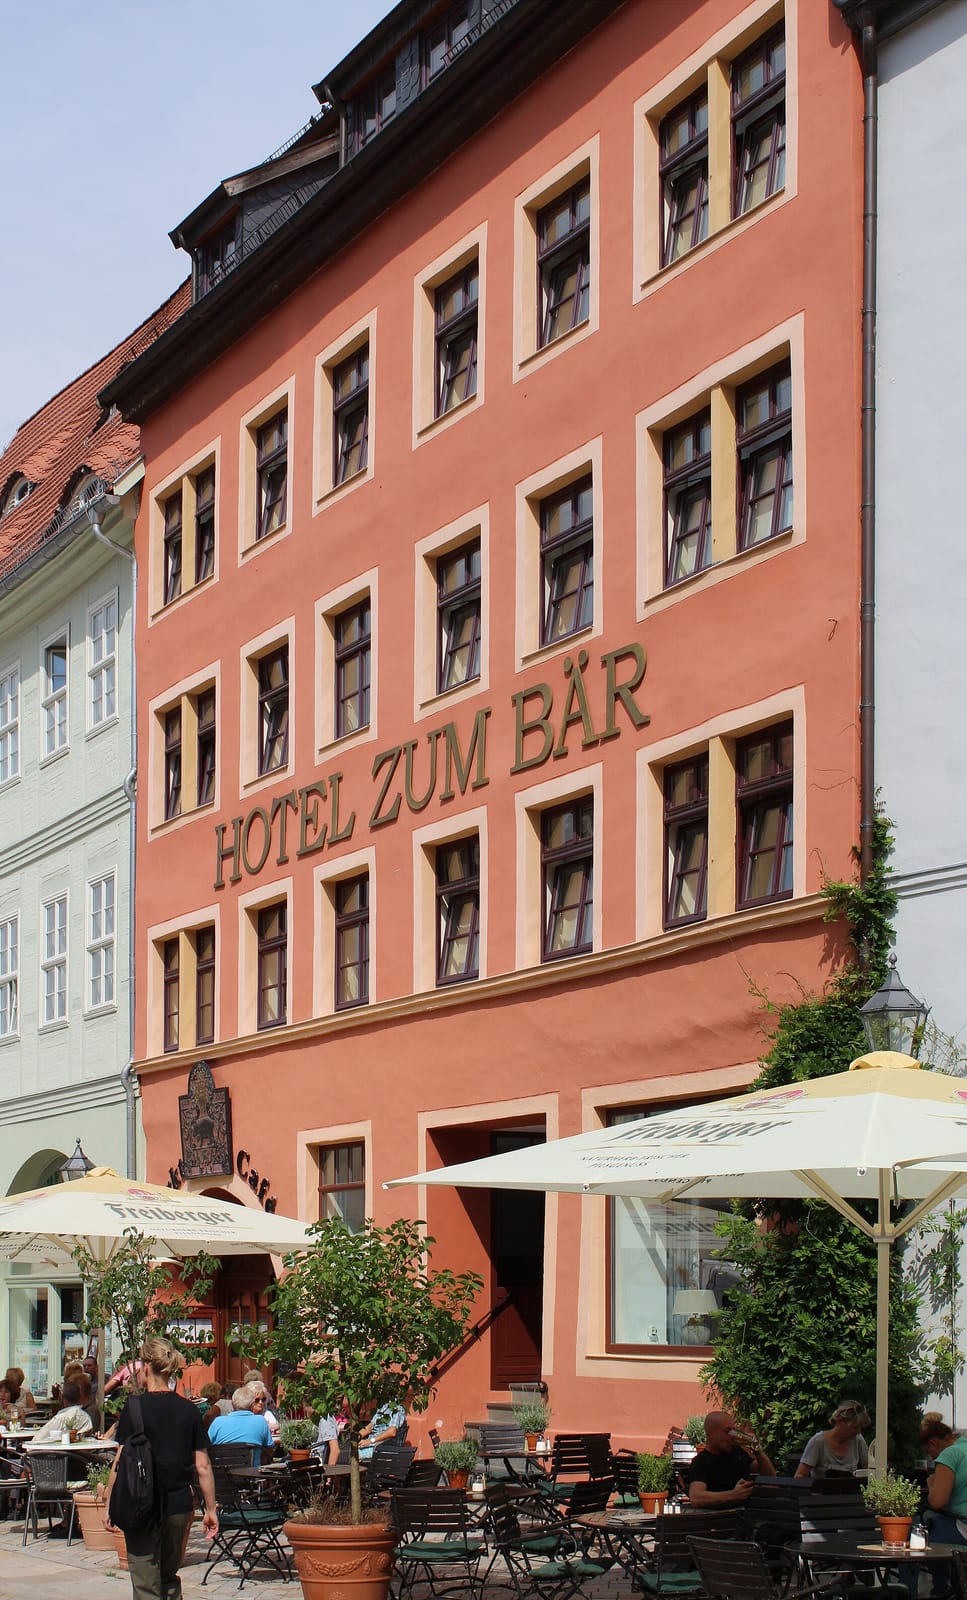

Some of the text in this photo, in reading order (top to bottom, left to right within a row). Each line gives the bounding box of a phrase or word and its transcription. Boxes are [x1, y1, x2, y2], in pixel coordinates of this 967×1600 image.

[213, 642, 651, 888] HOTEL ZUM BÄR
[104, 1202, 236, 1225] Freiberger
